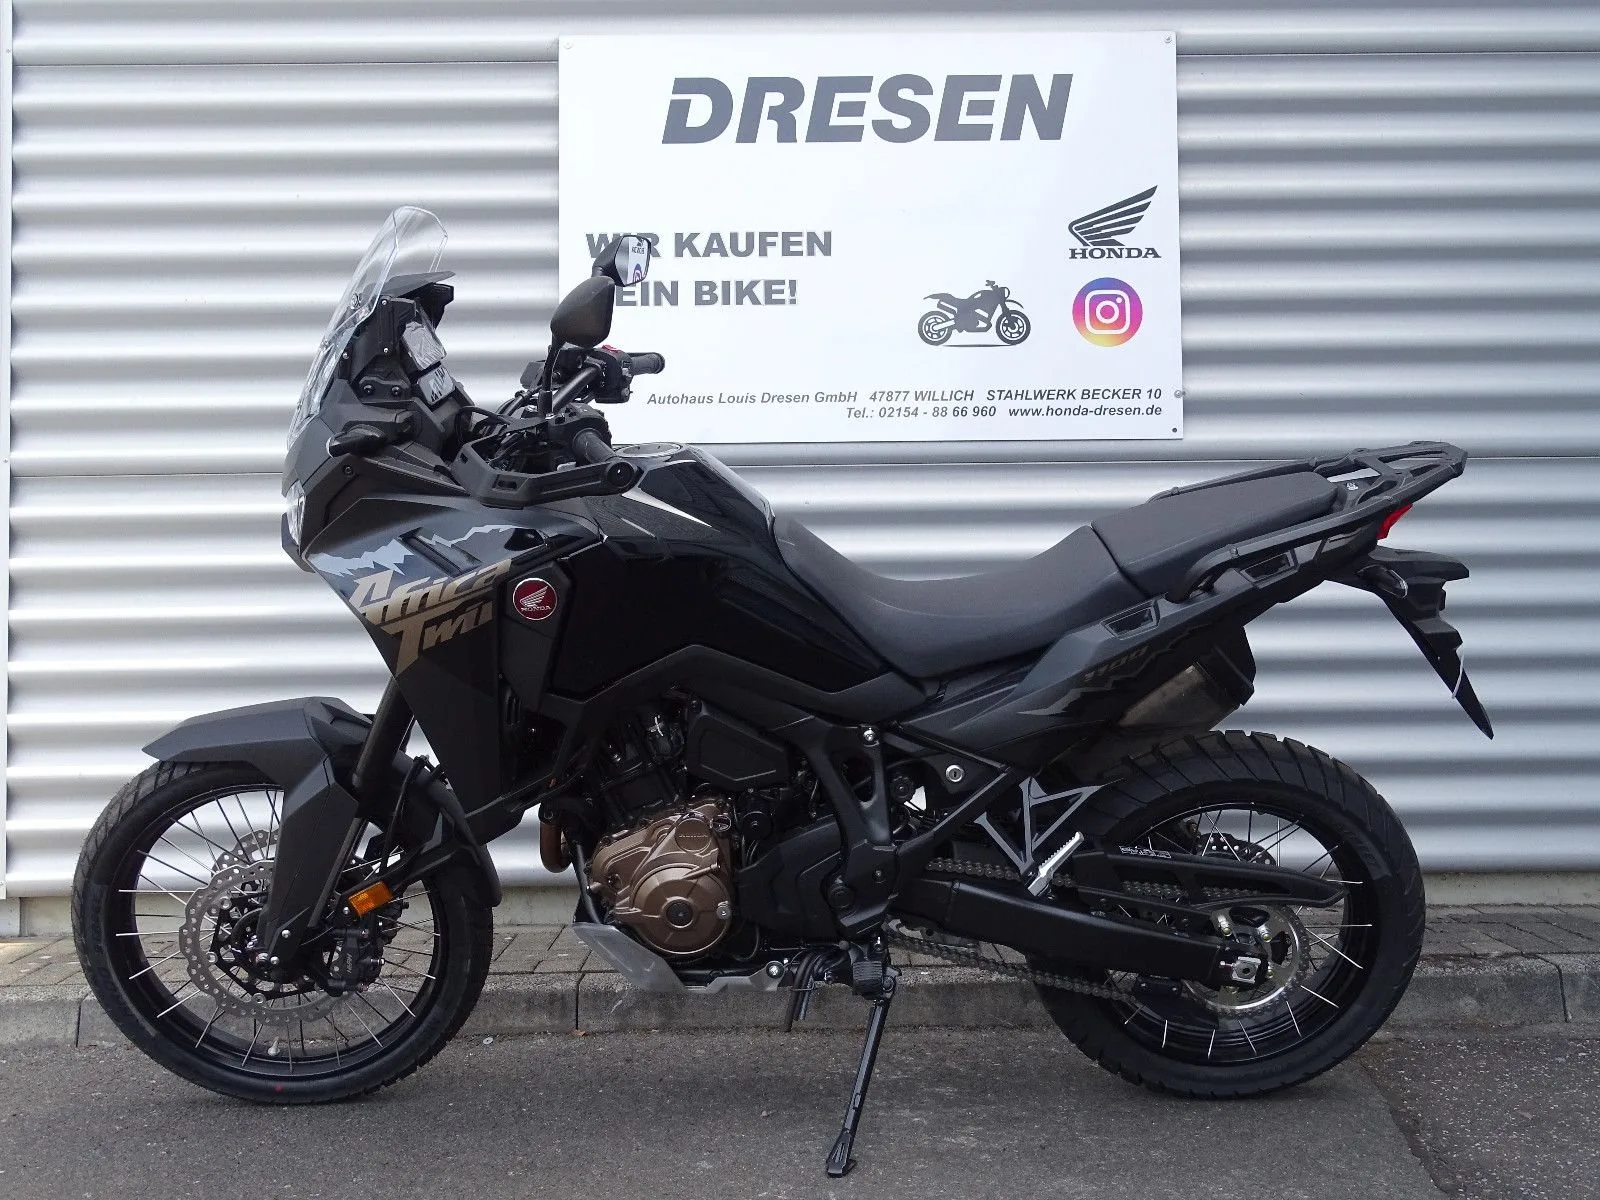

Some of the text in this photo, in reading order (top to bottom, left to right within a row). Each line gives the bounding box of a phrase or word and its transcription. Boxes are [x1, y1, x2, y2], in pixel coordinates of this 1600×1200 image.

[661, 73, 1074, 145] DRESEN
[674, 230, 833, 258] KAUFEN
[1068, 247, 1163, 260] HONDA
[694, 278, 797, 307] BIKE!
[646, 387, 1162, 405] Autohaus Louis Dresen GmbH 47877 WILLICH STAHLWERK BECKER 10
[846, 406, 875, 419] Tel.:
[878, 406, 919, 419] 02154
[931, 406, 948, 418] 88
[952, 405, 969, 418] 66
[971, 405, 997, 418] 960
[1008, 403, 1163, 417] www.honda-dresen.de
